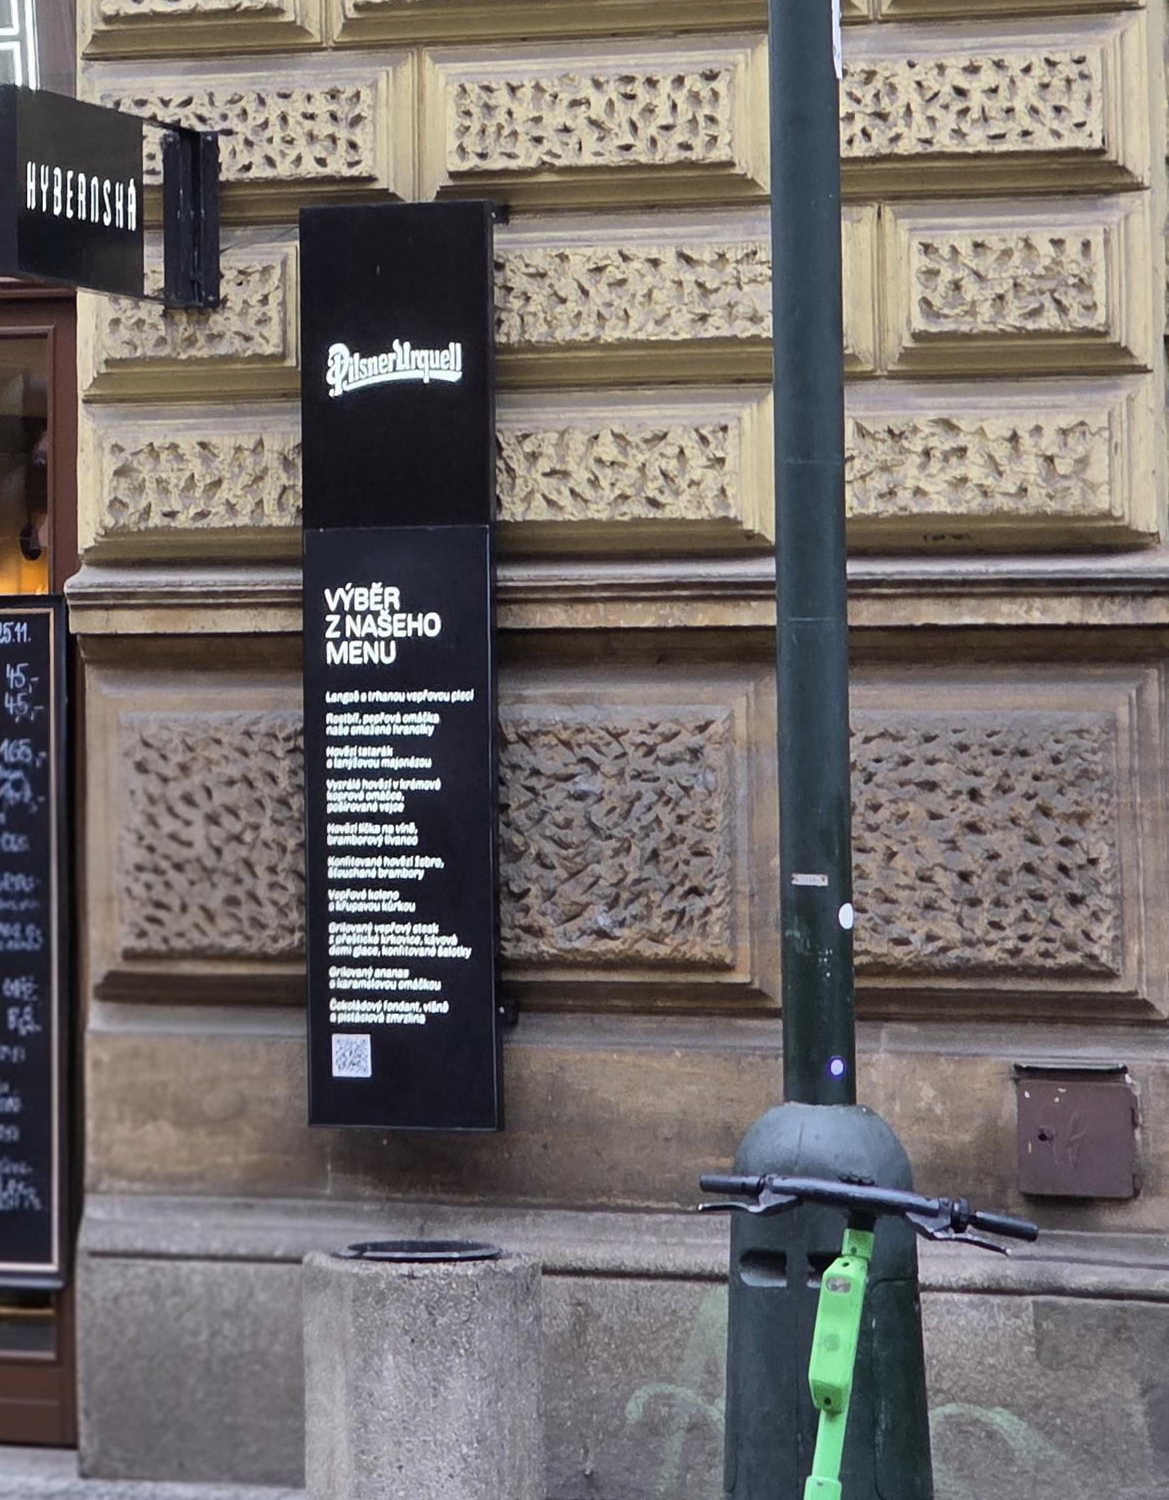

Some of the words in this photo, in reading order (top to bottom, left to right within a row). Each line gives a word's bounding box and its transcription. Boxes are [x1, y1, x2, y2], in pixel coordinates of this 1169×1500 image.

[25, 160, 138, 232] HYBERNSKÁ
[325, 341, 397, 398] Pilsner
[394, 339, 463, 384] Urquell
[324, 582, 401, 611] VÝBĚR
[325, 614, 342, 638] Z
[345, 609, 442, 638] NAŠEHO
[325, 640, 397, 665] MENU
